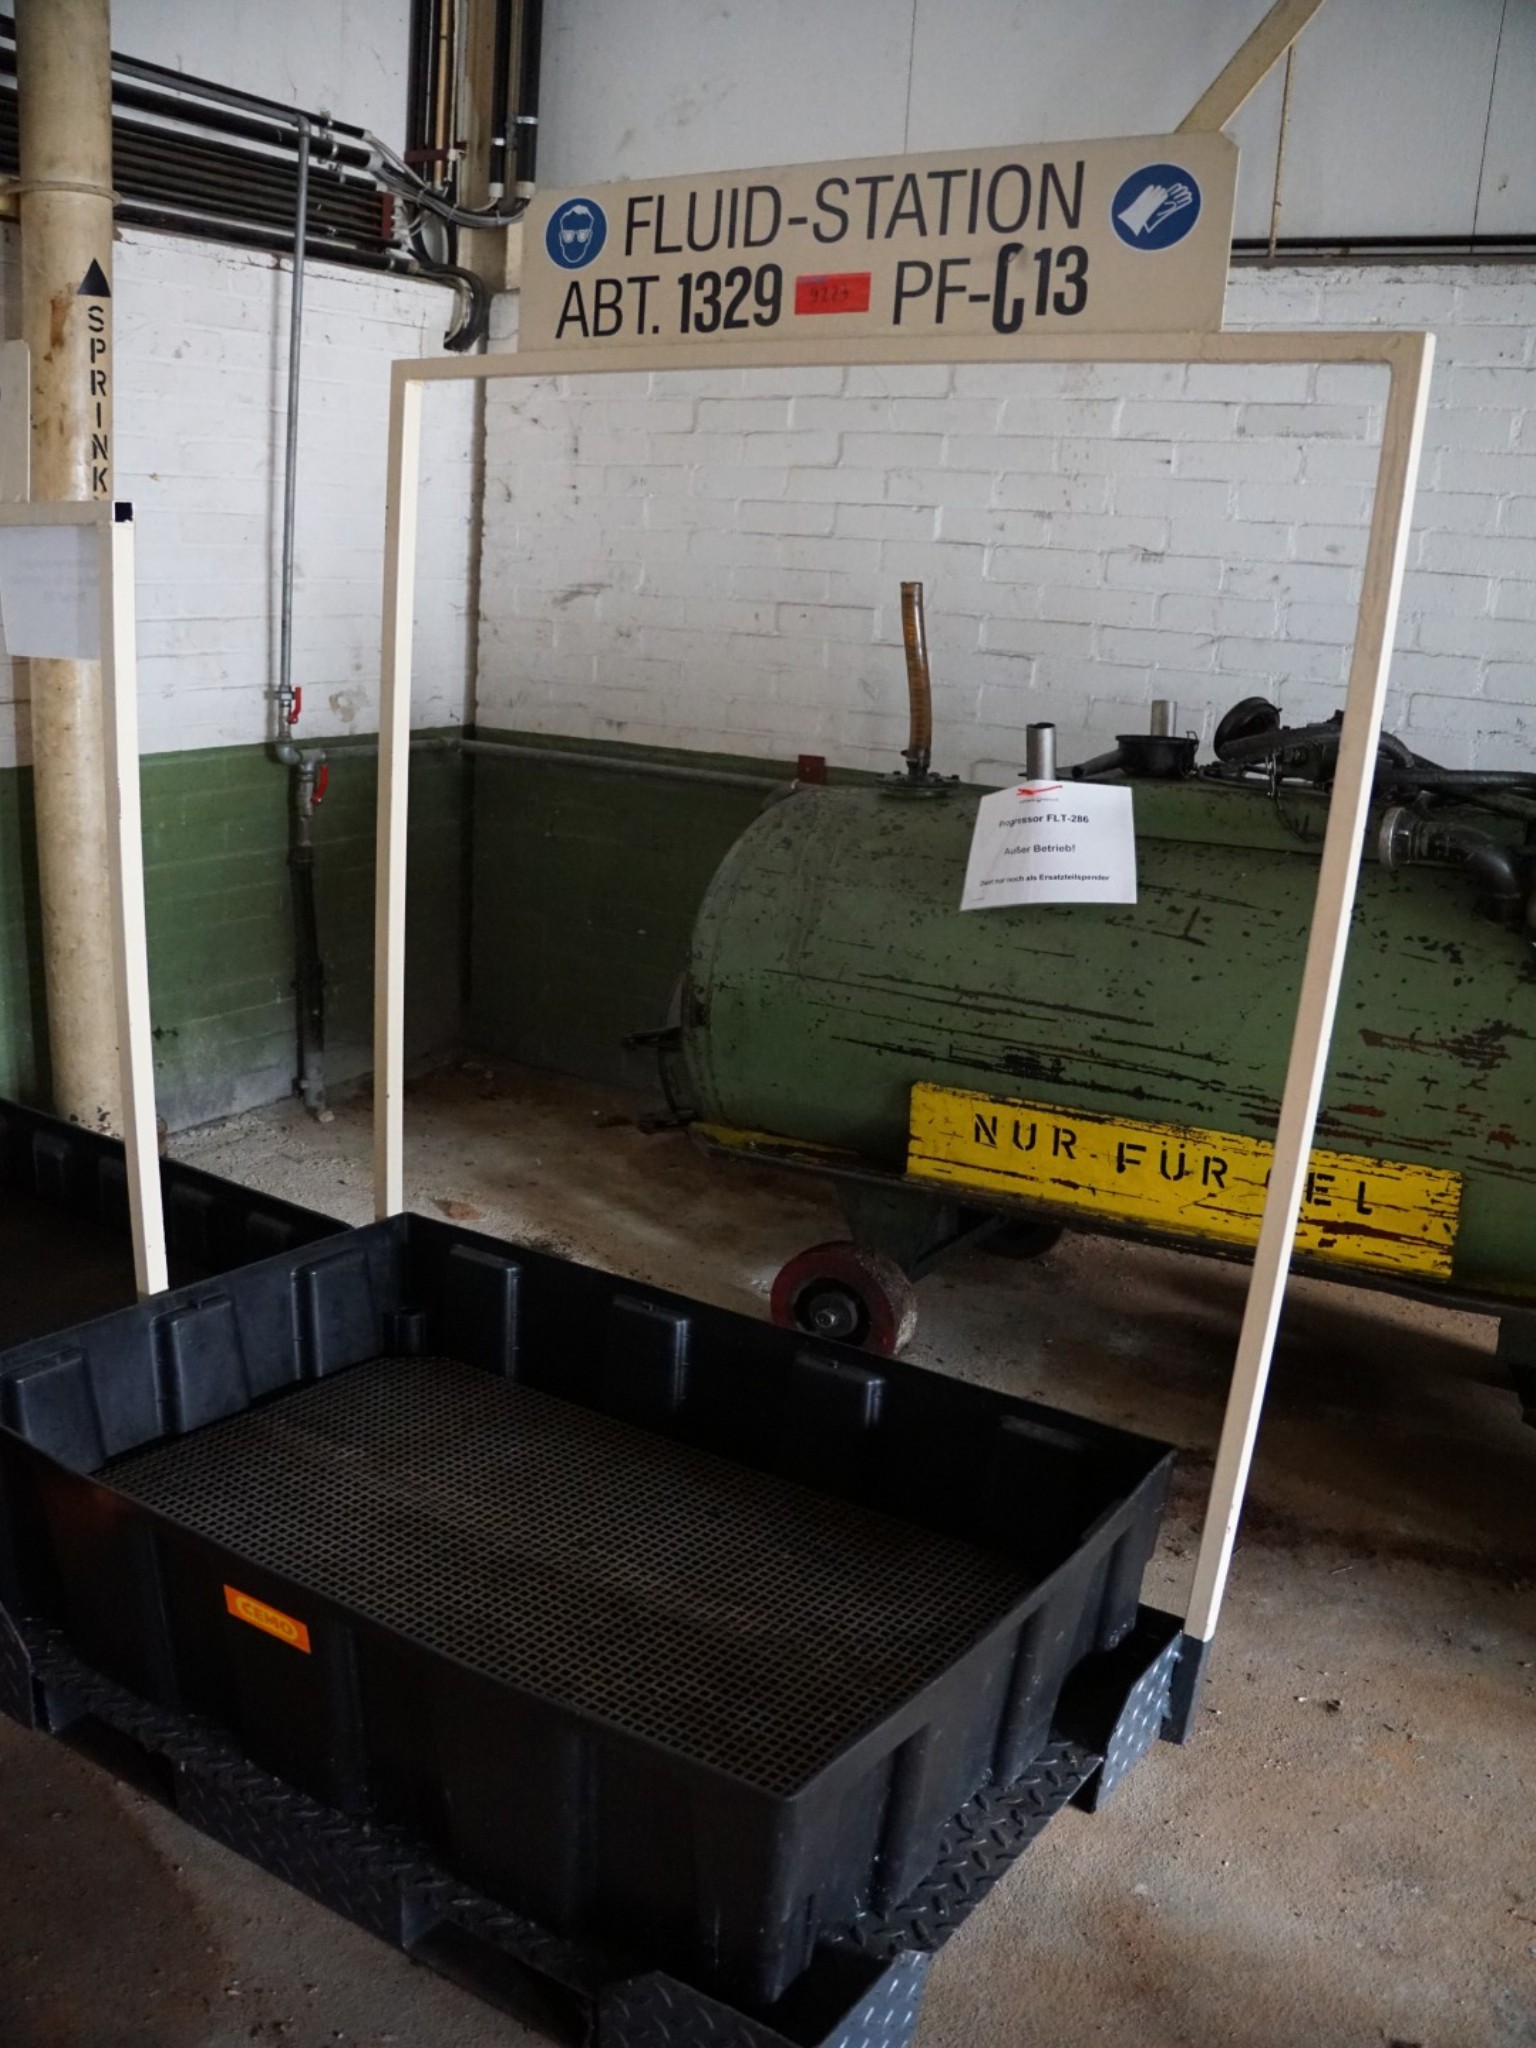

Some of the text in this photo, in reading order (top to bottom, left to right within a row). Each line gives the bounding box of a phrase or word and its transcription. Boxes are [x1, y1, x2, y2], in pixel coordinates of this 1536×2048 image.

[624, 161, 1085, 257] FLUID-STATION
[555, 275, 660, 339] ABT.
[677, 263, 783, 334] 1329
[88, 305, 108, 500] SPRINK
[1033, 843, 1076, 853] Betrieb!
[1046, 813, 1090, 824] FLT-286
[974, 1113, 1373, 1216] NUR FÜR EL
[240, 1601, 295, 1636] CEMO
